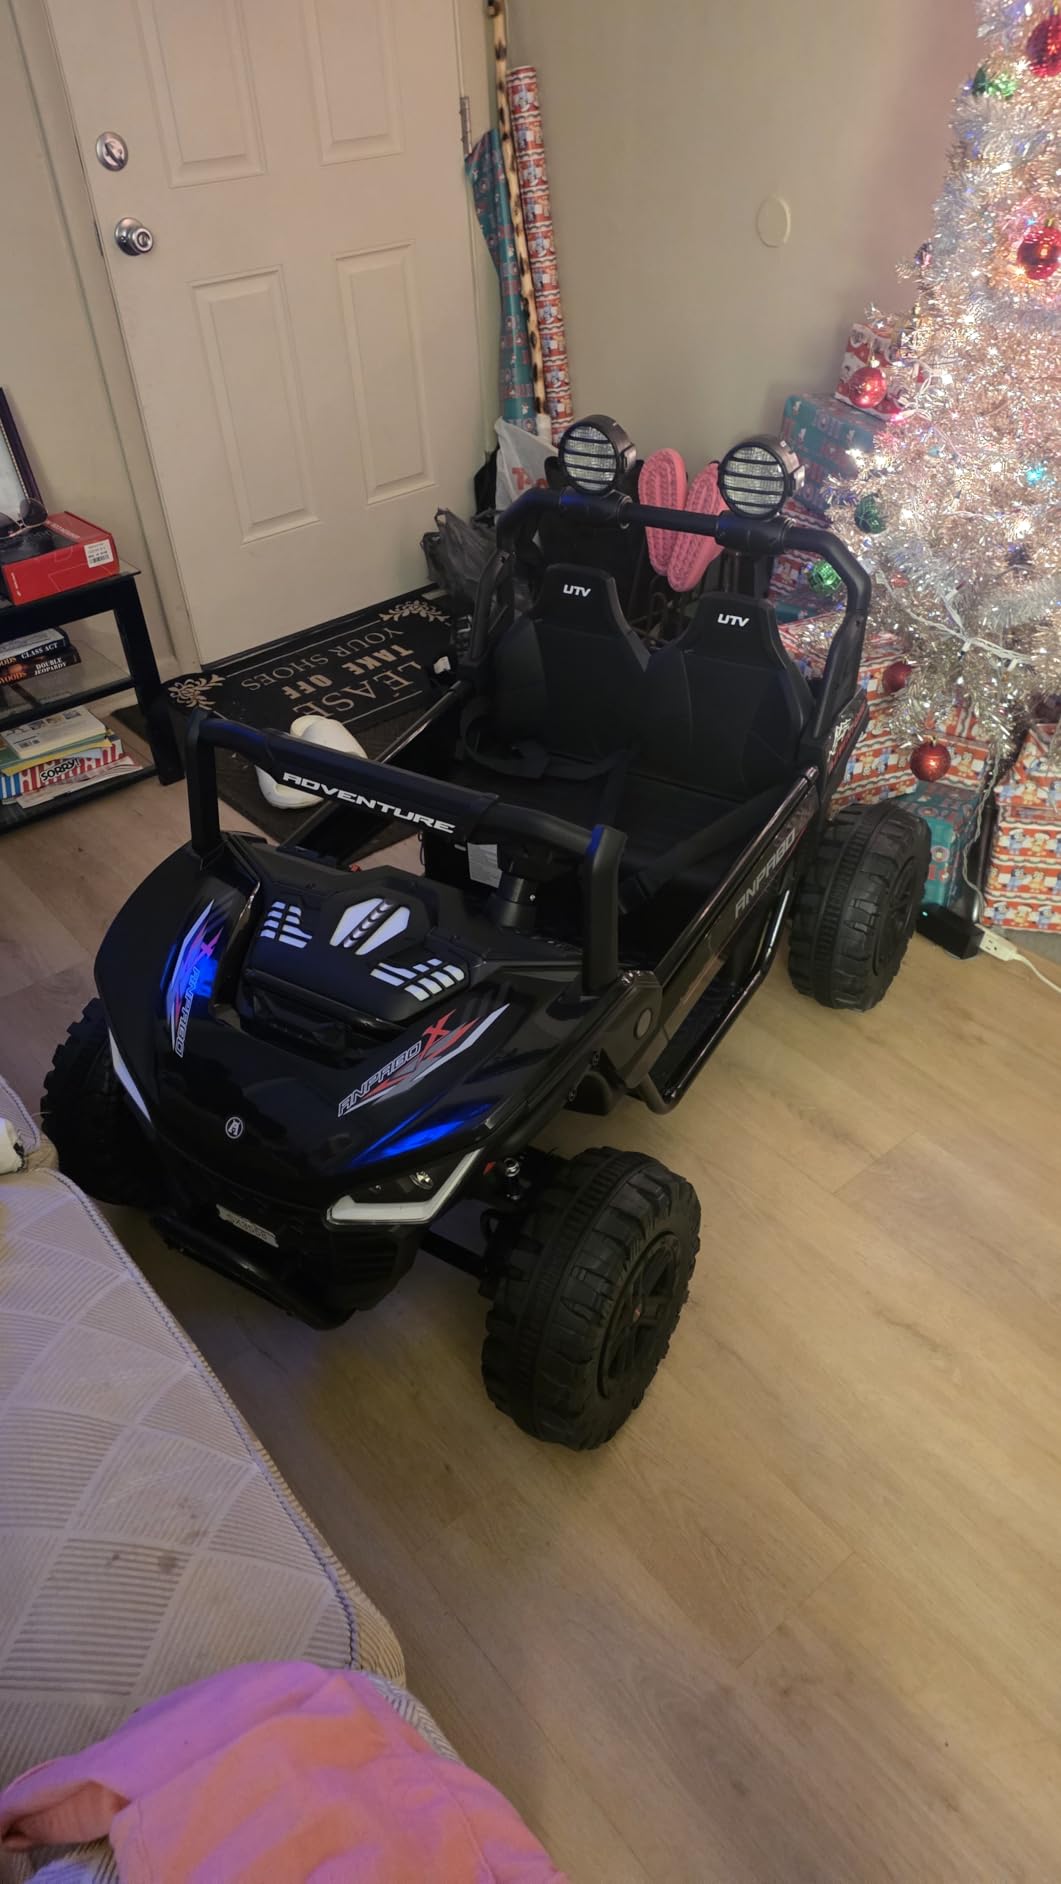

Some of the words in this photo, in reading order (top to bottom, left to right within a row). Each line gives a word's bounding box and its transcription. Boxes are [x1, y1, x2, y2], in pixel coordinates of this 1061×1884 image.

[562, 583, 591, 597] UTV
[716, 613, 749, 628] UTV
[20, 646, 44, 660] CLASS
[45, 641, 59, 653] ACT
[328, 627, 404, 657] YOUR
[34, 661, 67, 676] JEOPARDY
[35, 656, 64, 670] DOUBLE
[240, 653, 329, 691] SHOES
[342, 644, 415, 676] TAKE
[281, 674, 333, 700] OFF
[40, 757, 81, 782] SORRY!
[282, 771, 456, 834] ADVENTURE
